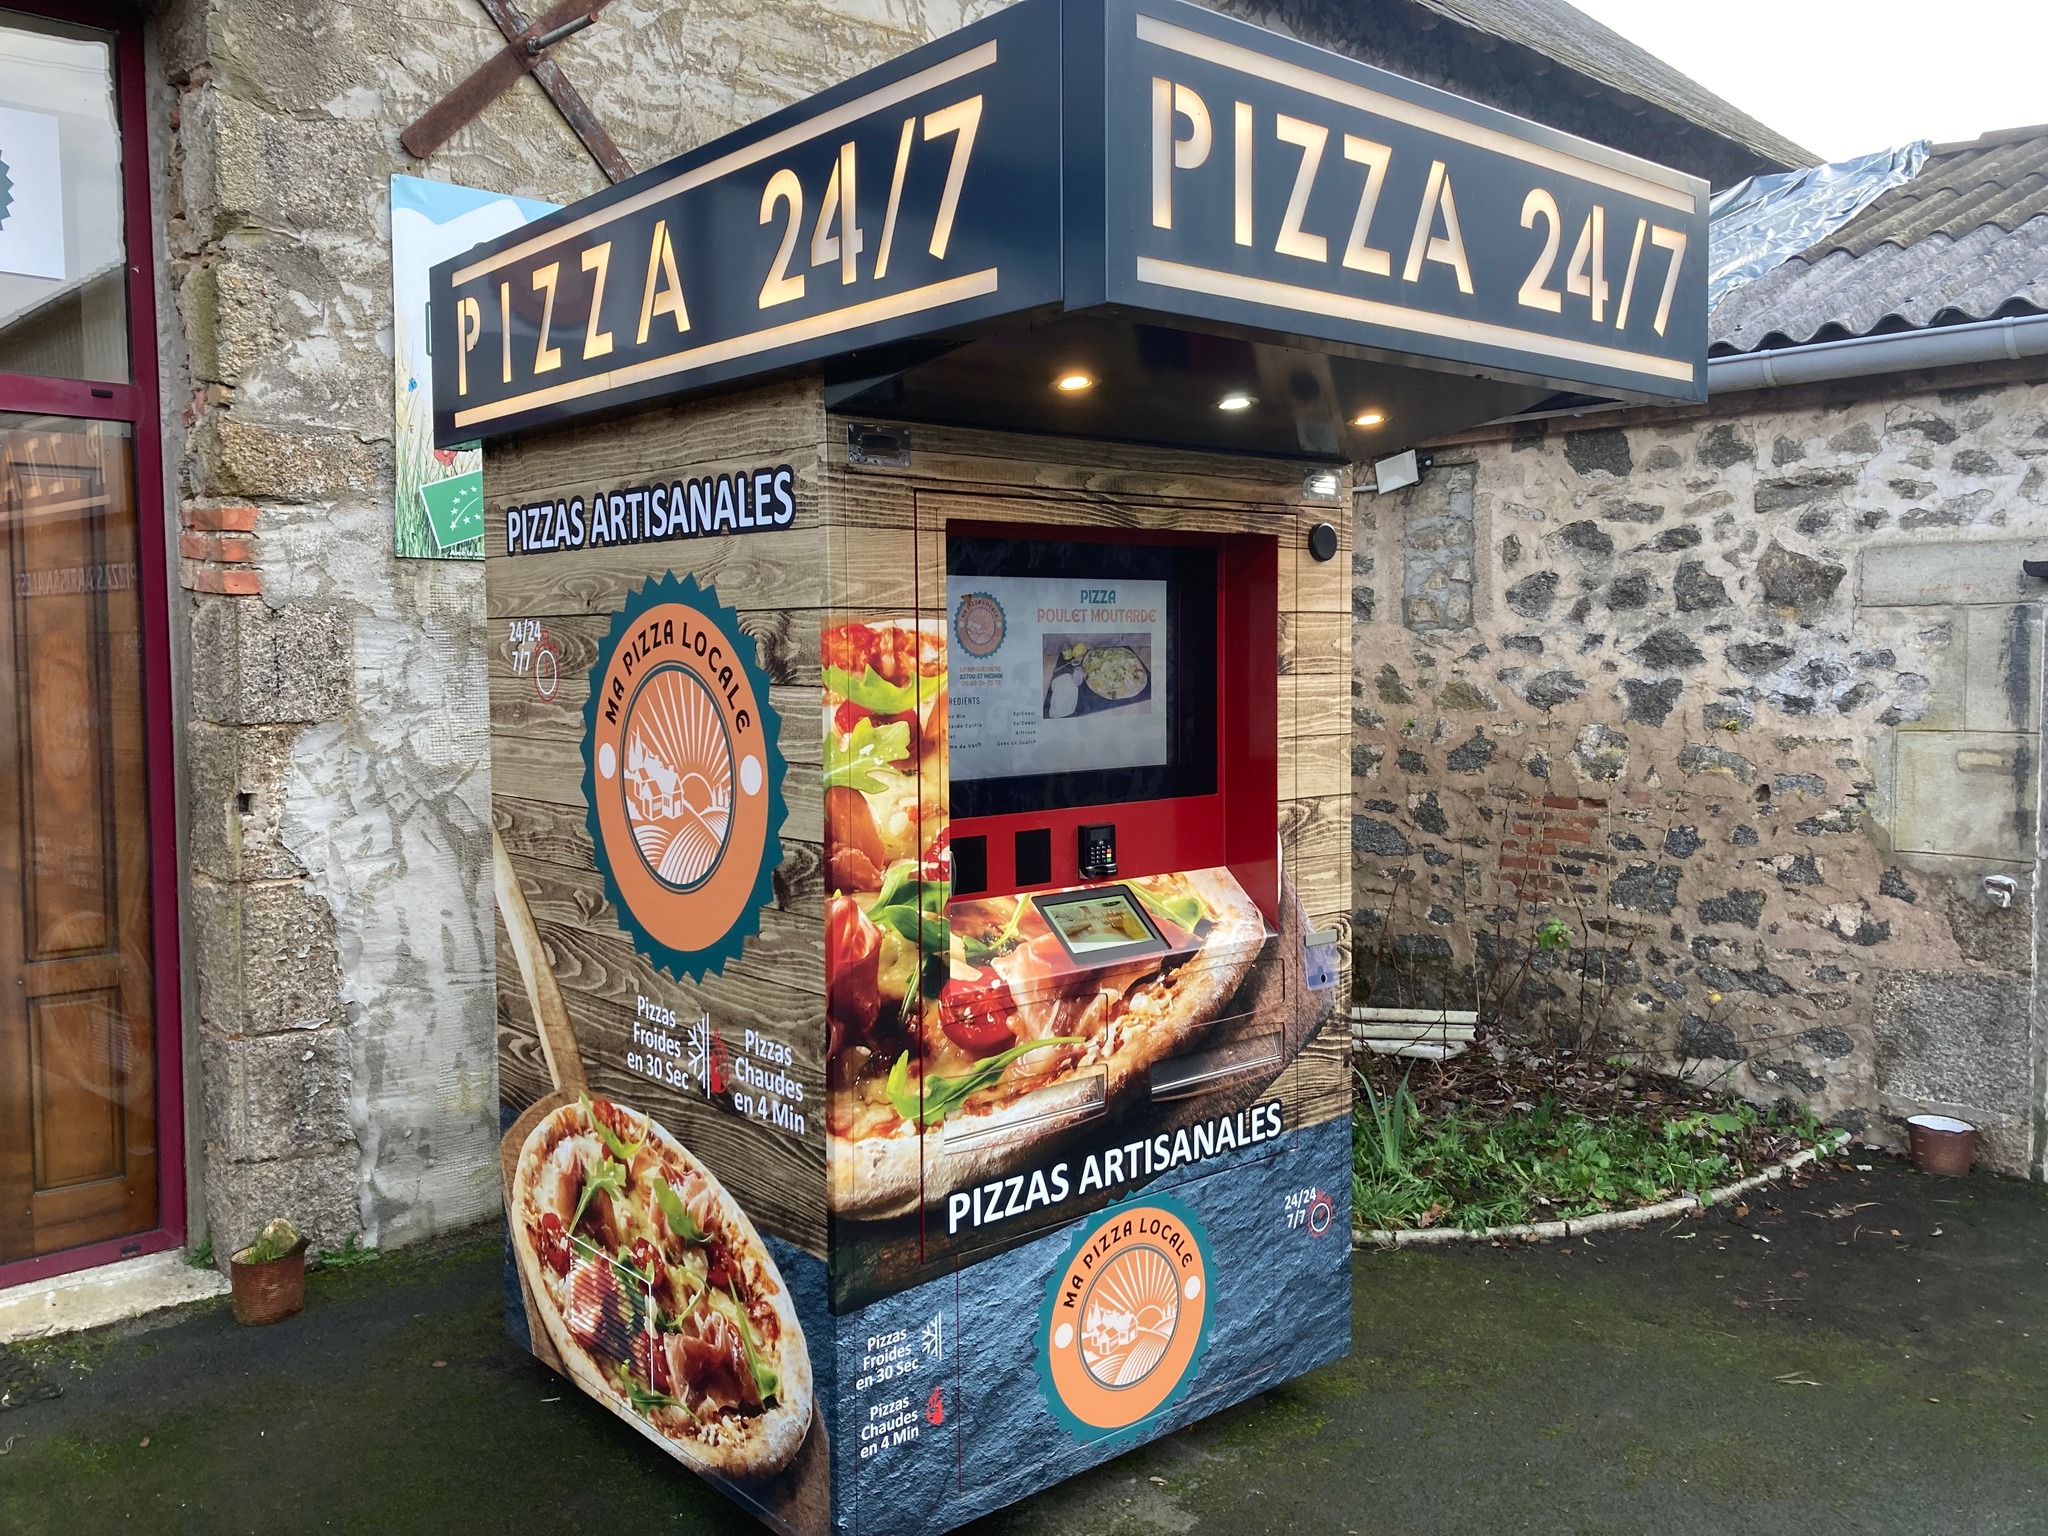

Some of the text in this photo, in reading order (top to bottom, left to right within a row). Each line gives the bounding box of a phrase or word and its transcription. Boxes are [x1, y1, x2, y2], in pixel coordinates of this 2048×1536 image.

[1151, 76, 1688, 338] PIZZA 24/7
[456, 94, 983, 396] PIZZA 24/7
[507, 470, 794, 552] PIZZAS ARTISANALES
[1080, 589, 1116, 604] PIZZA
[509, 618, 542, 646] 24/24
[1037, 608, 1157, 623] POULET MOUTARDE
[512, 648, 531, 676] 7/7
[605, 619, 751, 734] MA PIZZA LOCALE
[637, 995, 676, 1028] Pizzas
[633, 1022, 681, 1058] Froides
[744, 1028, 793, 1067] Pizzas
[627, 1052, 690, 1090] en 30 Sec
[734, 1056, 804, 1102] Chaudes
[734, 1090, 805, 1135] en 4 Min
[948, 1102, 1282, 1234] PIZZAS ARTISANALES
[1284, 1186, 1317, 1211] 24/24
[1286, 1208, 1306, 1230] 7/7
[1063, 1217, 1194, 1309] MA PIZZA LOCALE
[867, 1328, 908, 1352] Pizzas
[855, 1357, 919, 1391] en 30 Sec
[862, 1343, 912, 1372] Froides
[861, 1409, 919, 1441] Chaudes
[870, 1396, 910, 1421] Pizzas
[860, 1425, 920, 1459] en 4 Min
